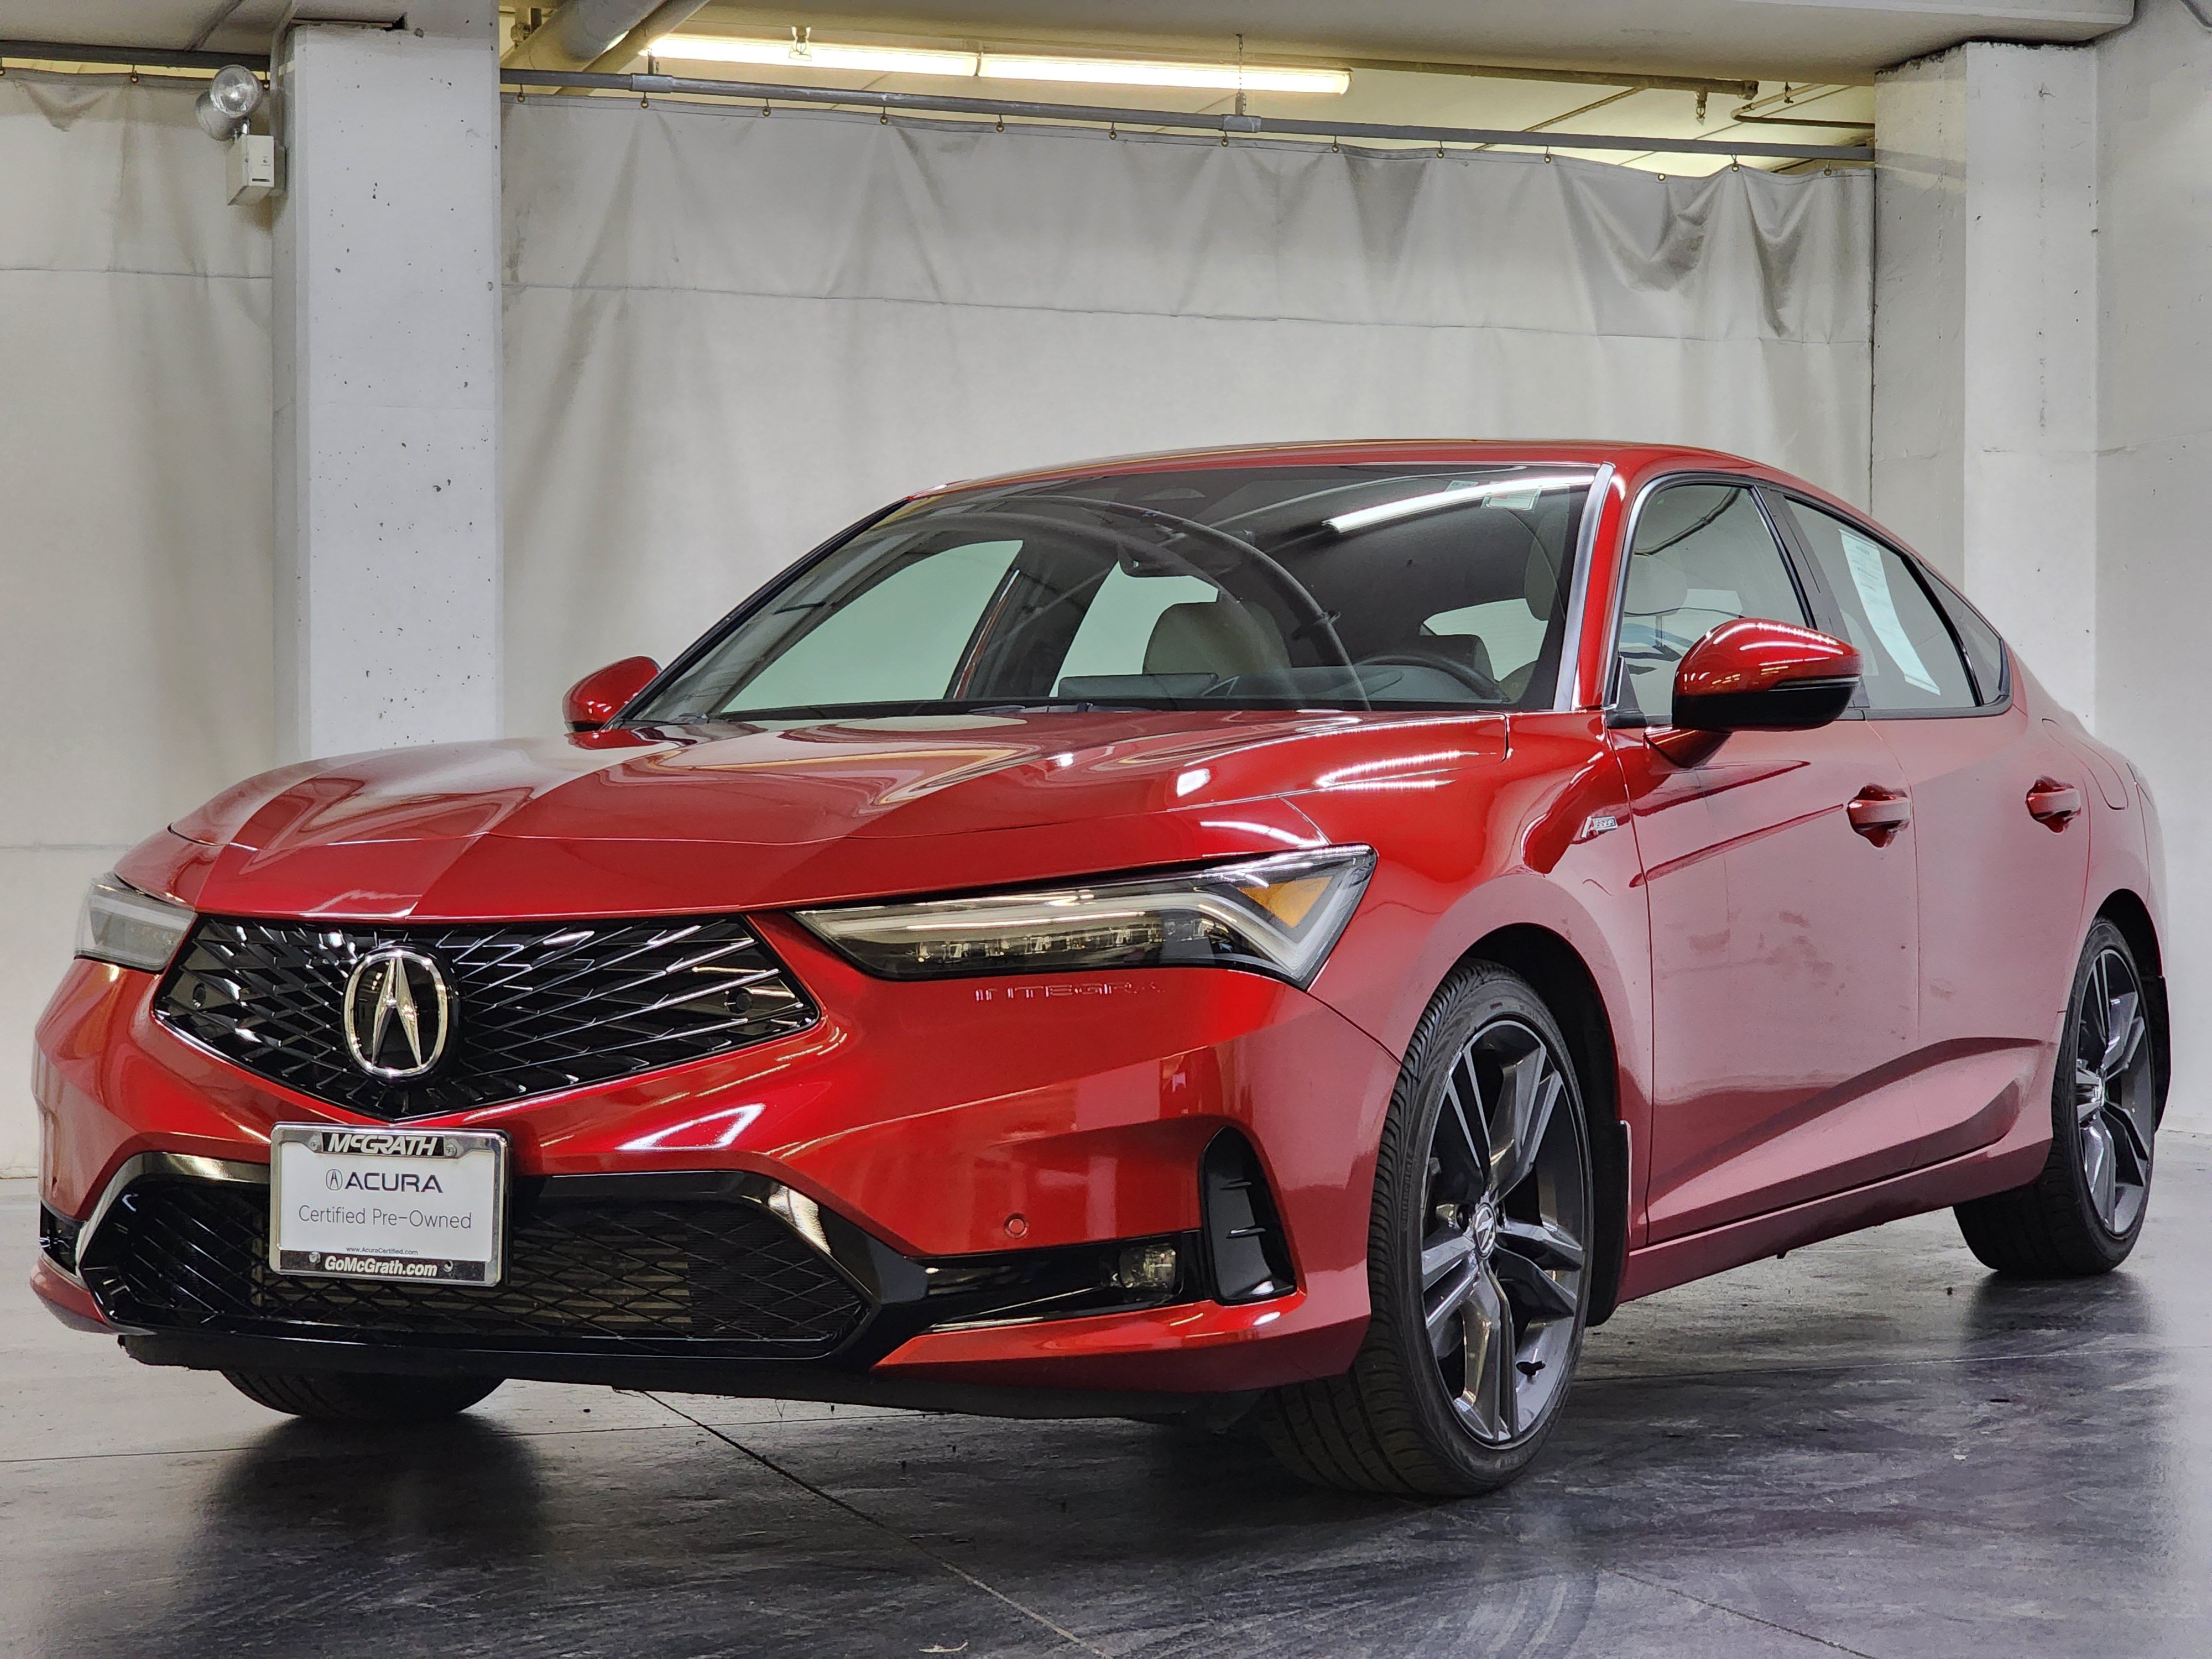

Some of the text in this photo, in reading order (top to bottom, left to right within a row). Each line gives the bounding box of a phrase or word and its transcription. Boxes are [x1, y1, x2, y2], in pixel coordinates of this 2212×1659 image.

[345, 1172, 443, 1193] ACURA
[298, 1205, 472, 1229] Certified Pre-Owned
[346, 1246, 419, 1255] www.AcuraCertified.com
[325, 1256, 437, 1276] GoMcGrath.com
